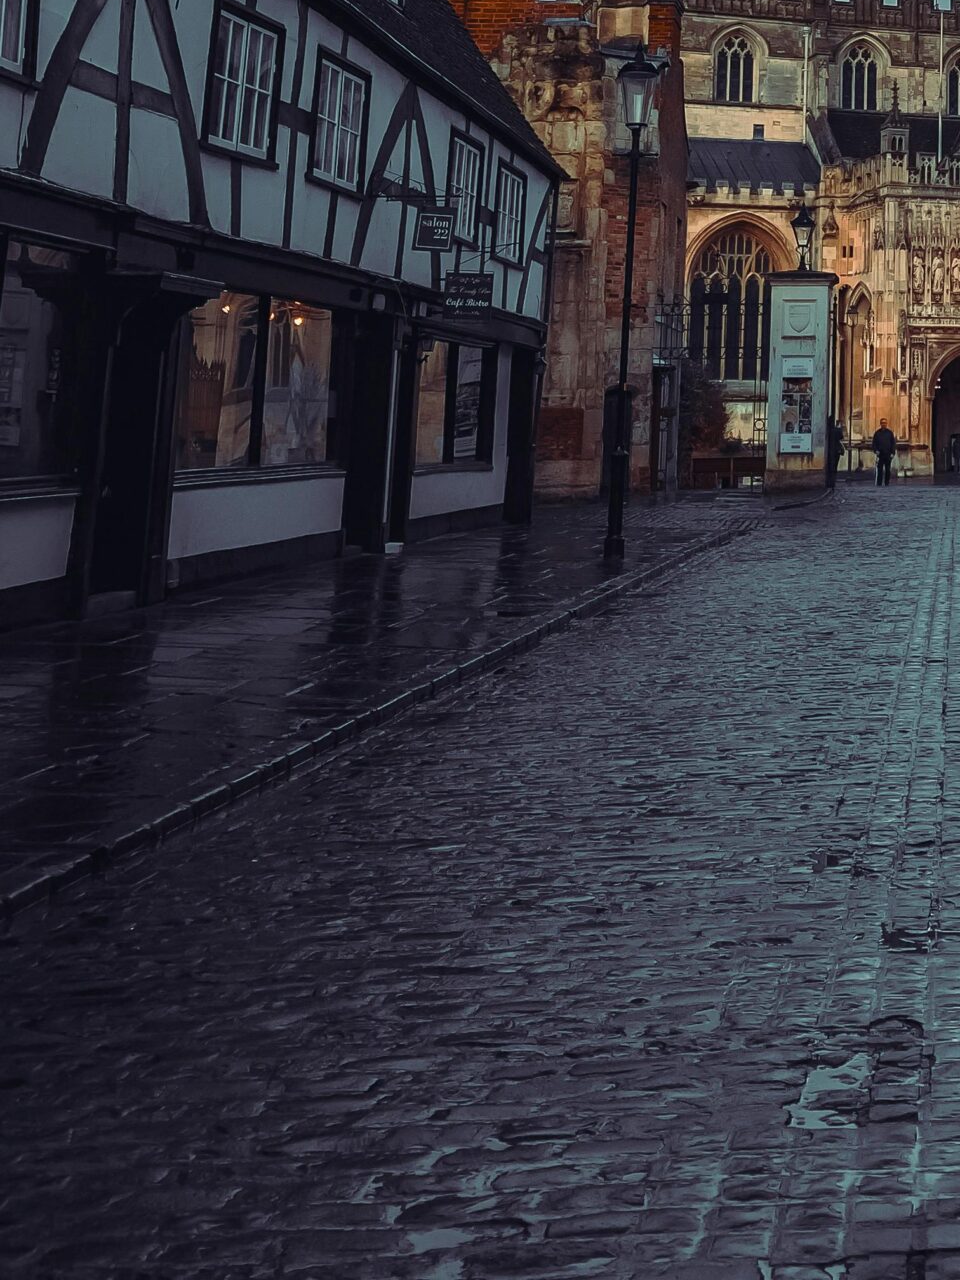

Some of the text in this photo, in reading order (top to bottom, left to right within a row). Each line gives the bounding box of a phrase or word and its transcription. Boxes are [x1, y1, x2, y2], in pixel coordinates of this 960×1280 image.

[422, 216, 449, 228] salon
[433, 228, 449, 239] 22
[446, 297, 489, 308] Café Bistro
